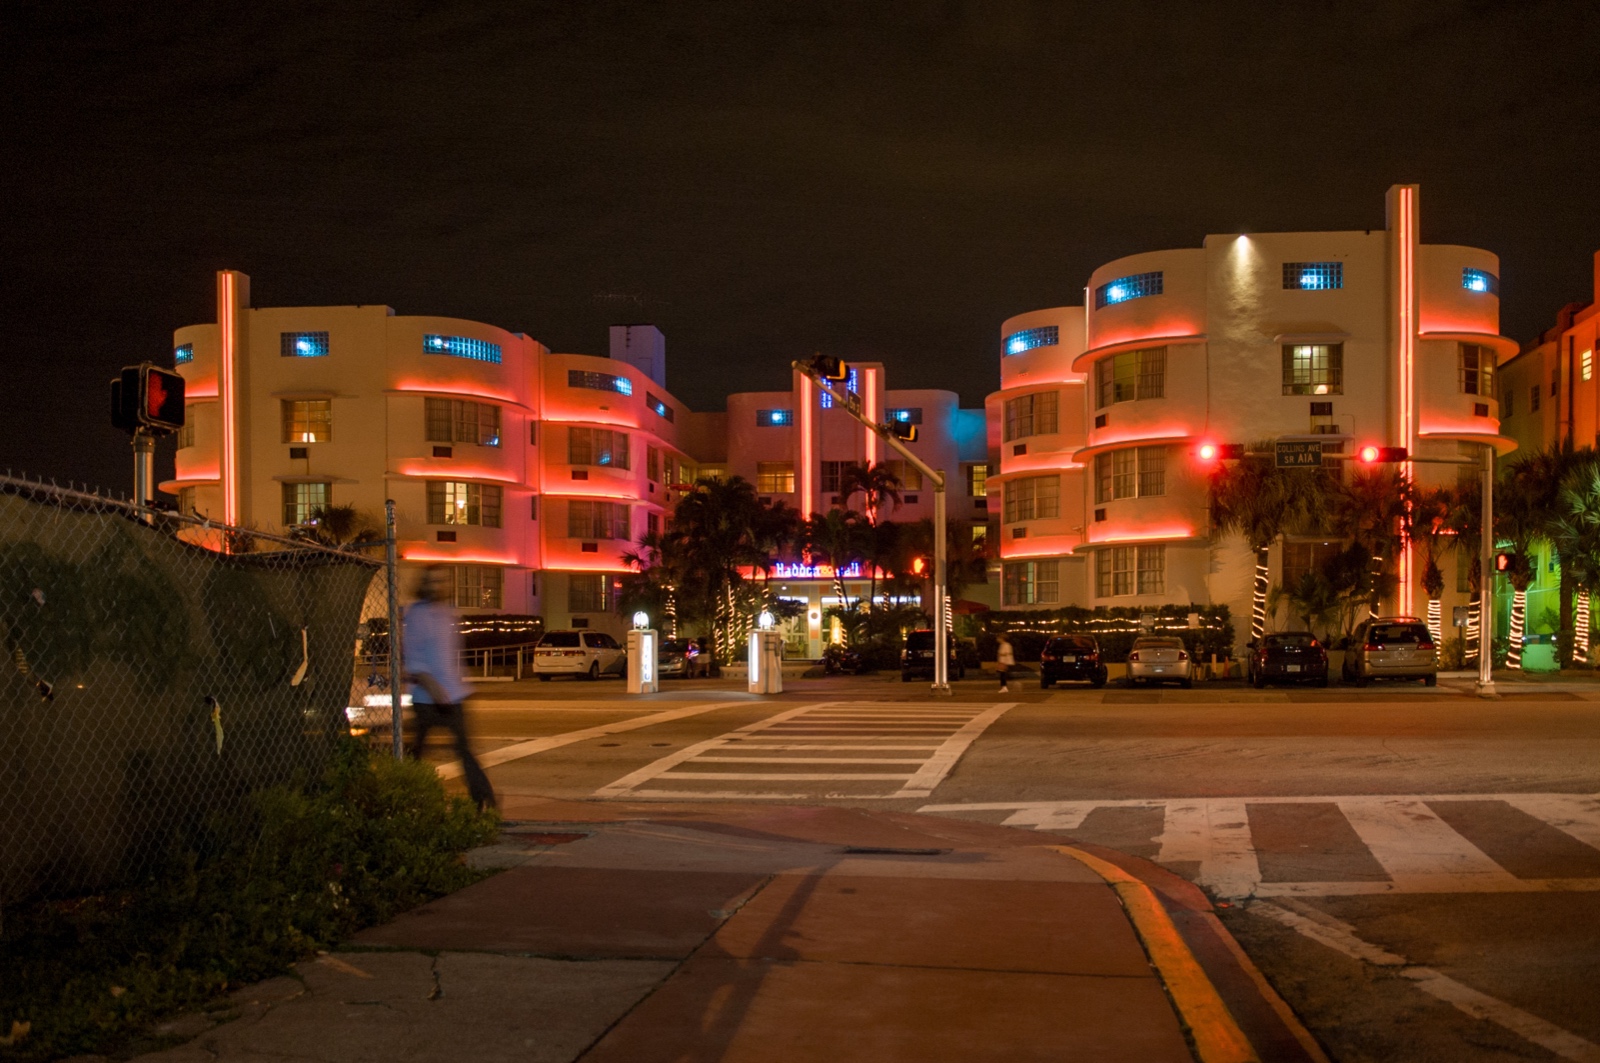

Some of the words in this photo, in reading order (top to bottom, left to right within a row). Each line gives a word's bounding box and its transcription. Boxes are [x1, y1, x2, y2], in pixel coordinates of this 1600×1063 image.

[1277, 445, 1304, 453] COLLINS
[1308, 444, 1320, 452] AVE
[1297, 453, 1314, 463] A1A
